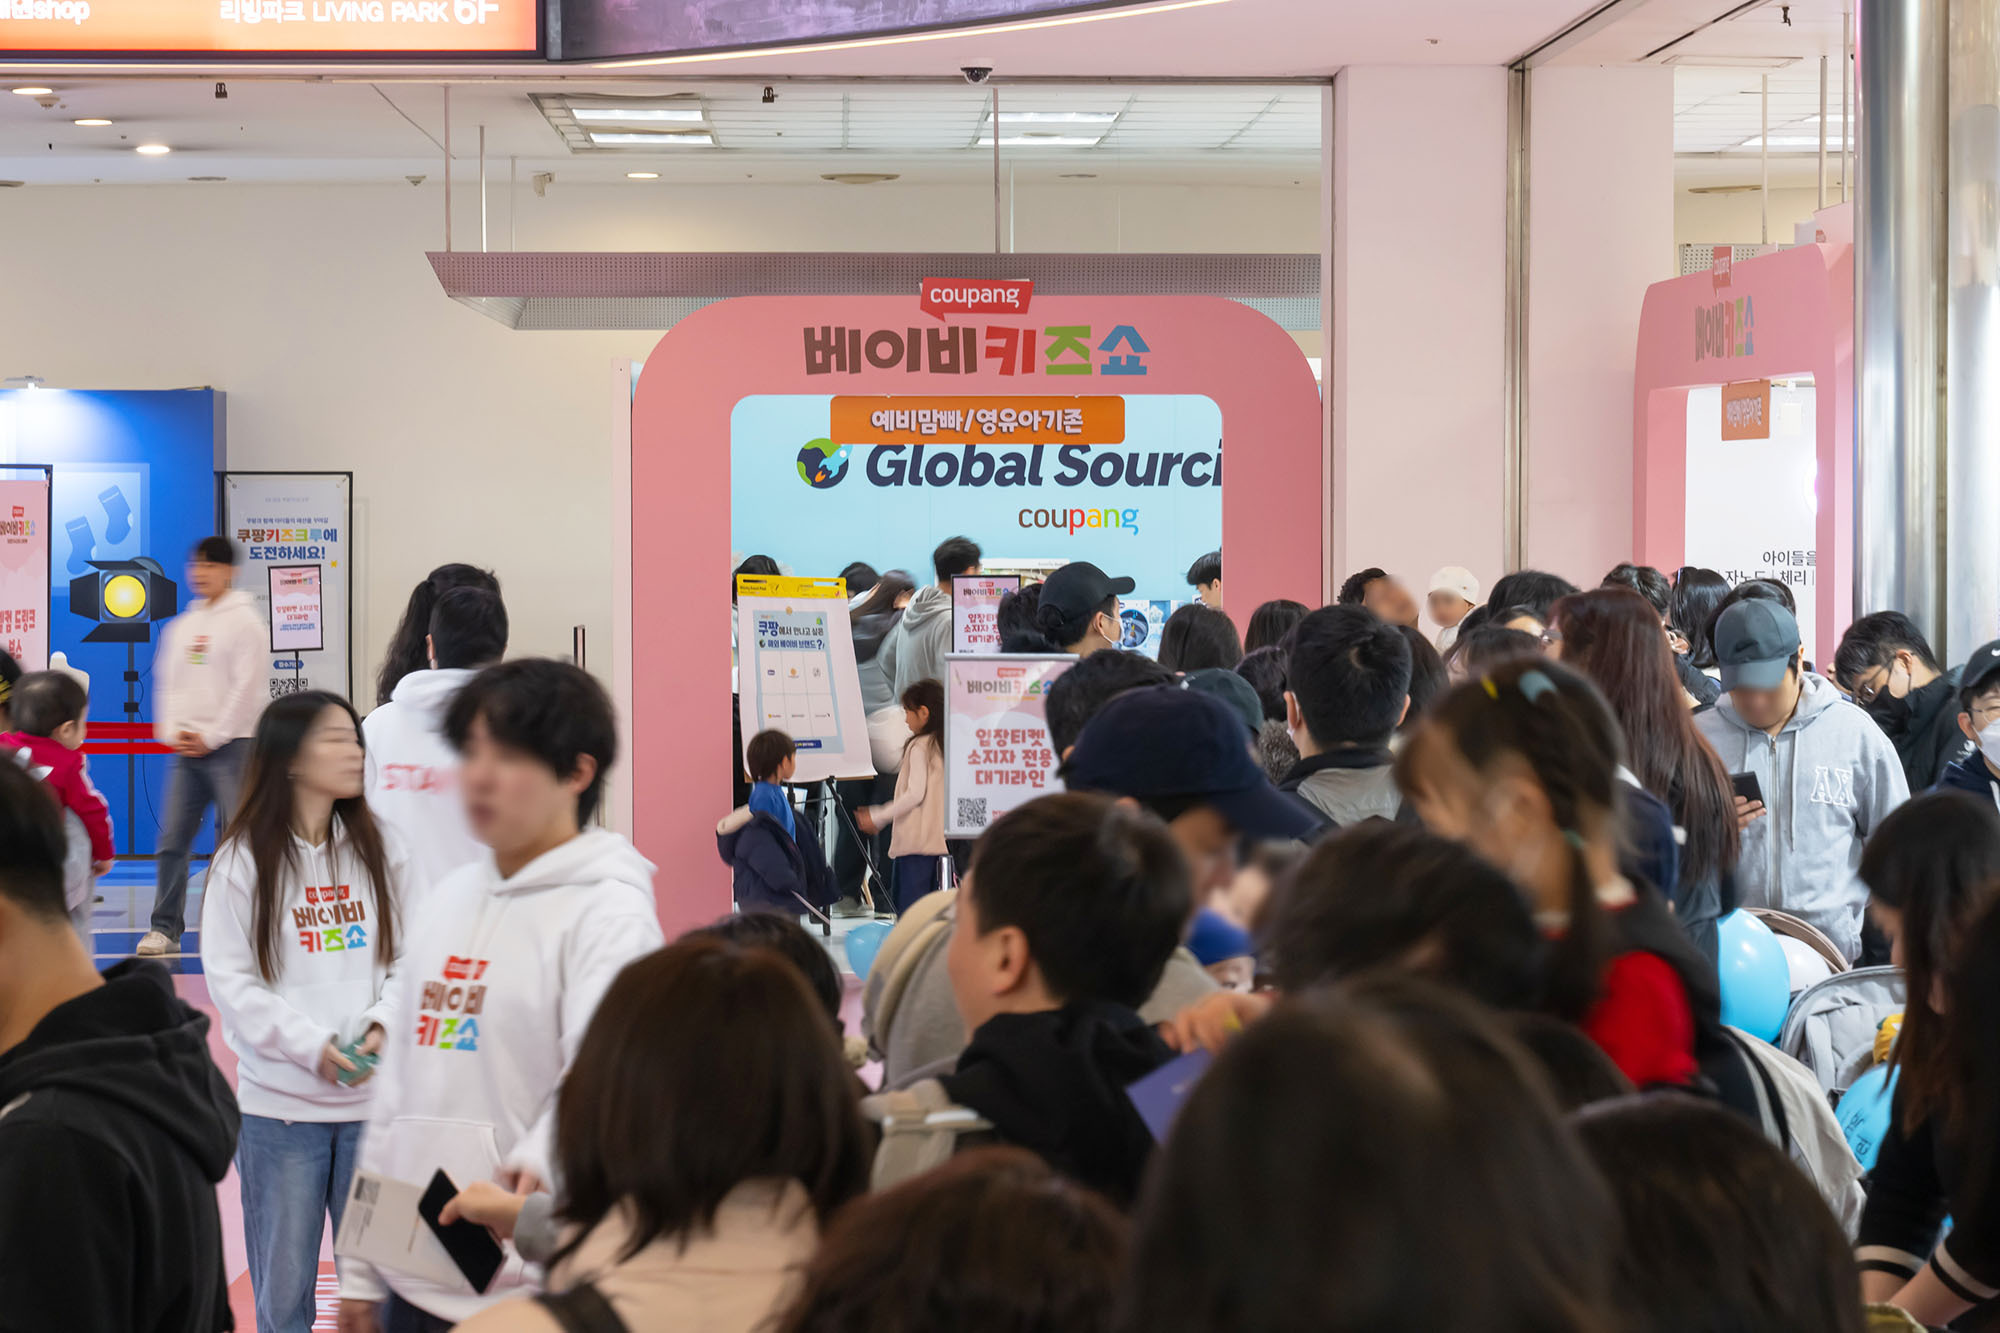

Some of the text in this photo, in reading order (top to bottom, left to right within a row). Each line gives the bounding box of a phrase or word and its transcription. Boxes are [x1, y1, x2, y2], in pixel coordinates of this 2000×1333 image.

[313, 1, 384, 22] LIVING
[391, 2, 449, 22] PARK
[930, 285, 1020, 308] coupang
[803, 325, 1151, 376] 베이비키즈쇼
[870, 408, 1083, 435] 예비맘빠/영유아기존
[866, 444, 1043, 487] Global
[1018, 508, 1139, 535] coupang
[237, 528, 338, 543] 쿠팡키즈크루에
[249, 546, 326, 560] 도전하세요!
[1762, 550, 1816, 567] 아이들을
[1780, 570, 1806, 586] 체리
[968, 613, 998, 624] 입장티
[975, 729, 1045, 747] 입장티켓
[968, 749, 1052, 768] 소지자 전용
[975, 775, 1045, 788] 대기라인
[292, 901, 366, 929] 베이비
[299, 925, 367, 953] 키즈쇼
[416, 1014, 480, 1052] 키즈쇼
